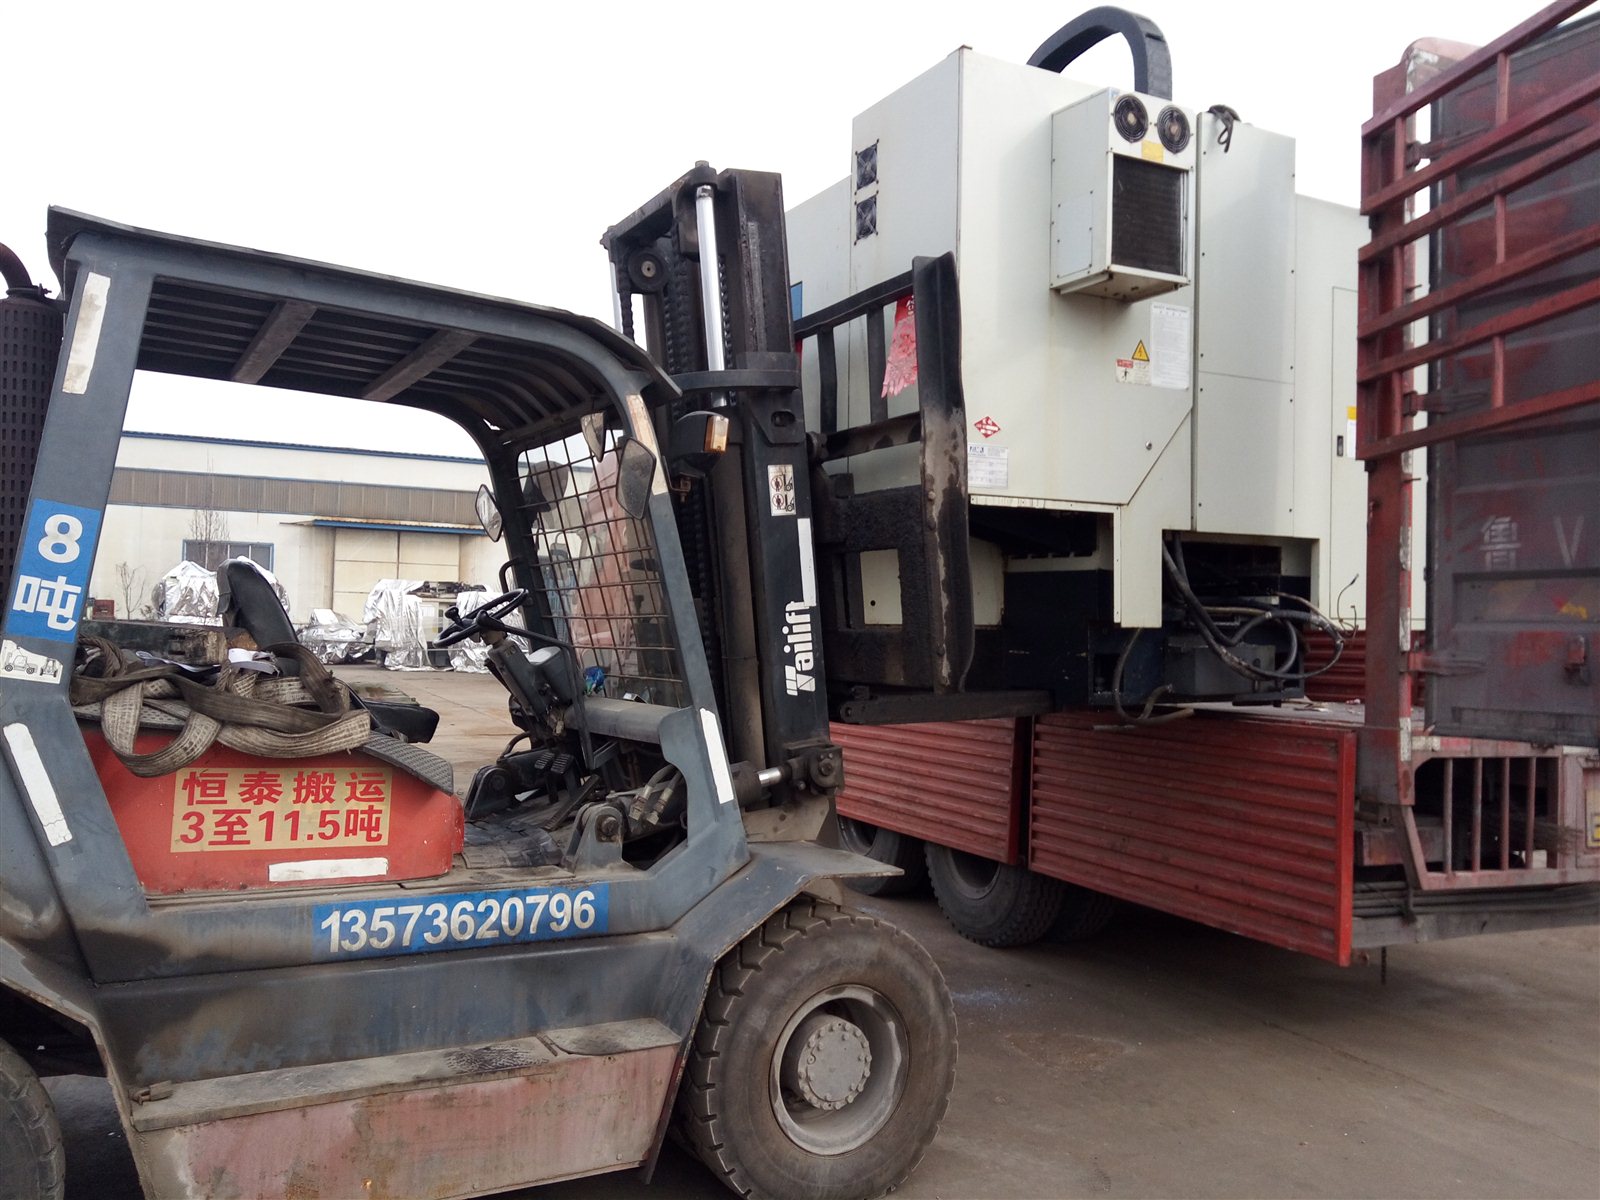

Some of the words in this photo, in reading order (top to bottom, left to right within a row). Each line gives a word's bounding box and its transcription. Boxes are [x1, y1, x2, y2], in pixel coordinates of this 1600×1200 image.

[38, 514, 83, 563] 8
[1480, 515, 1522, 571] 鲁
[13, 575, 82, 631] 吨
[182, 770, 386, 806] 恒泰搬运
[179, 805, 383, 846] 3至11.5吨
[321, 890, 596, 953] 13573620796
